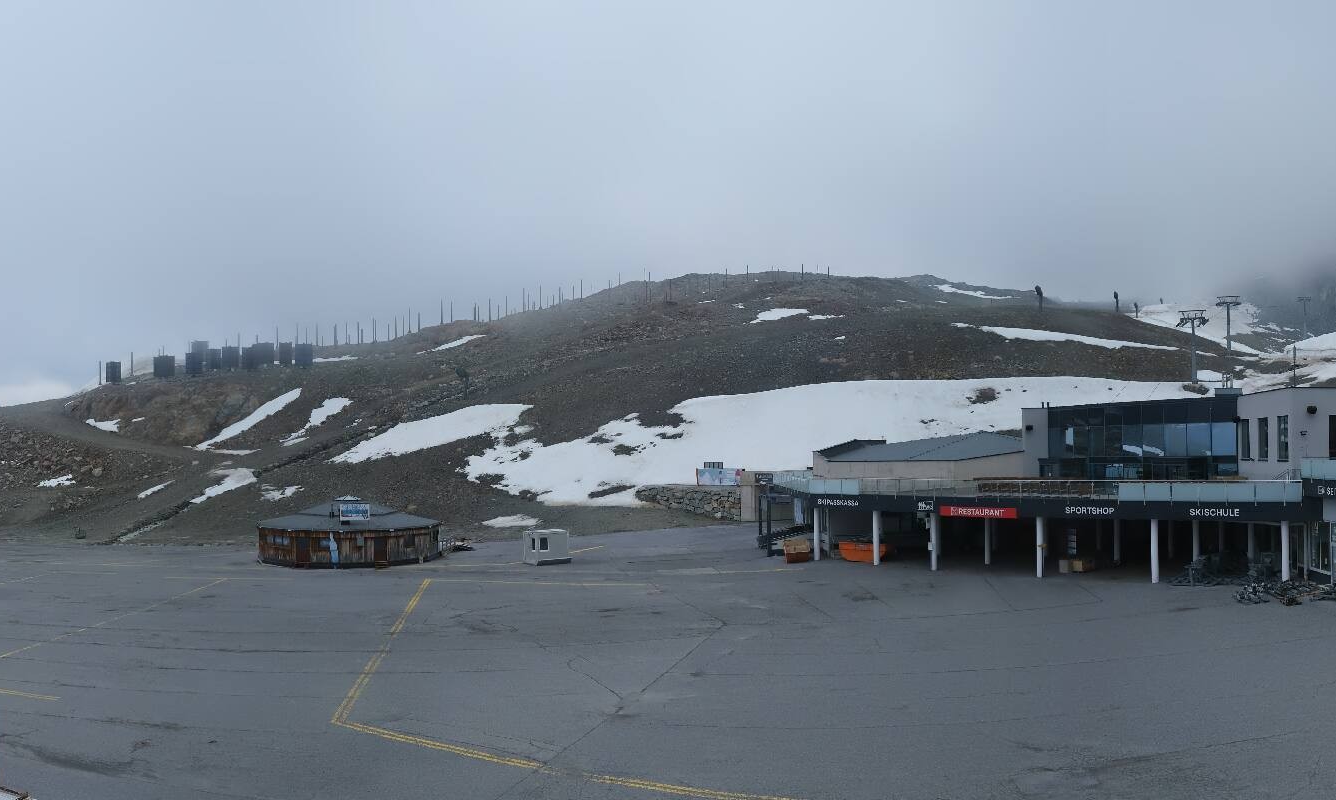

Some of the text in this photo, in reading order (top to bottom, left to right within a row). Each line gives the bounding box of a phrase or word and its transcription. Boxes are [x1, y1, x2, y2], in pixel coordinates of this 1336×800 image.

[958, 507, 1004, 517] RESTAURANT
[1065, 506, 1115, 515] SPORTSHOP
[1189, 508, 1240, 517] SKISCHULE
